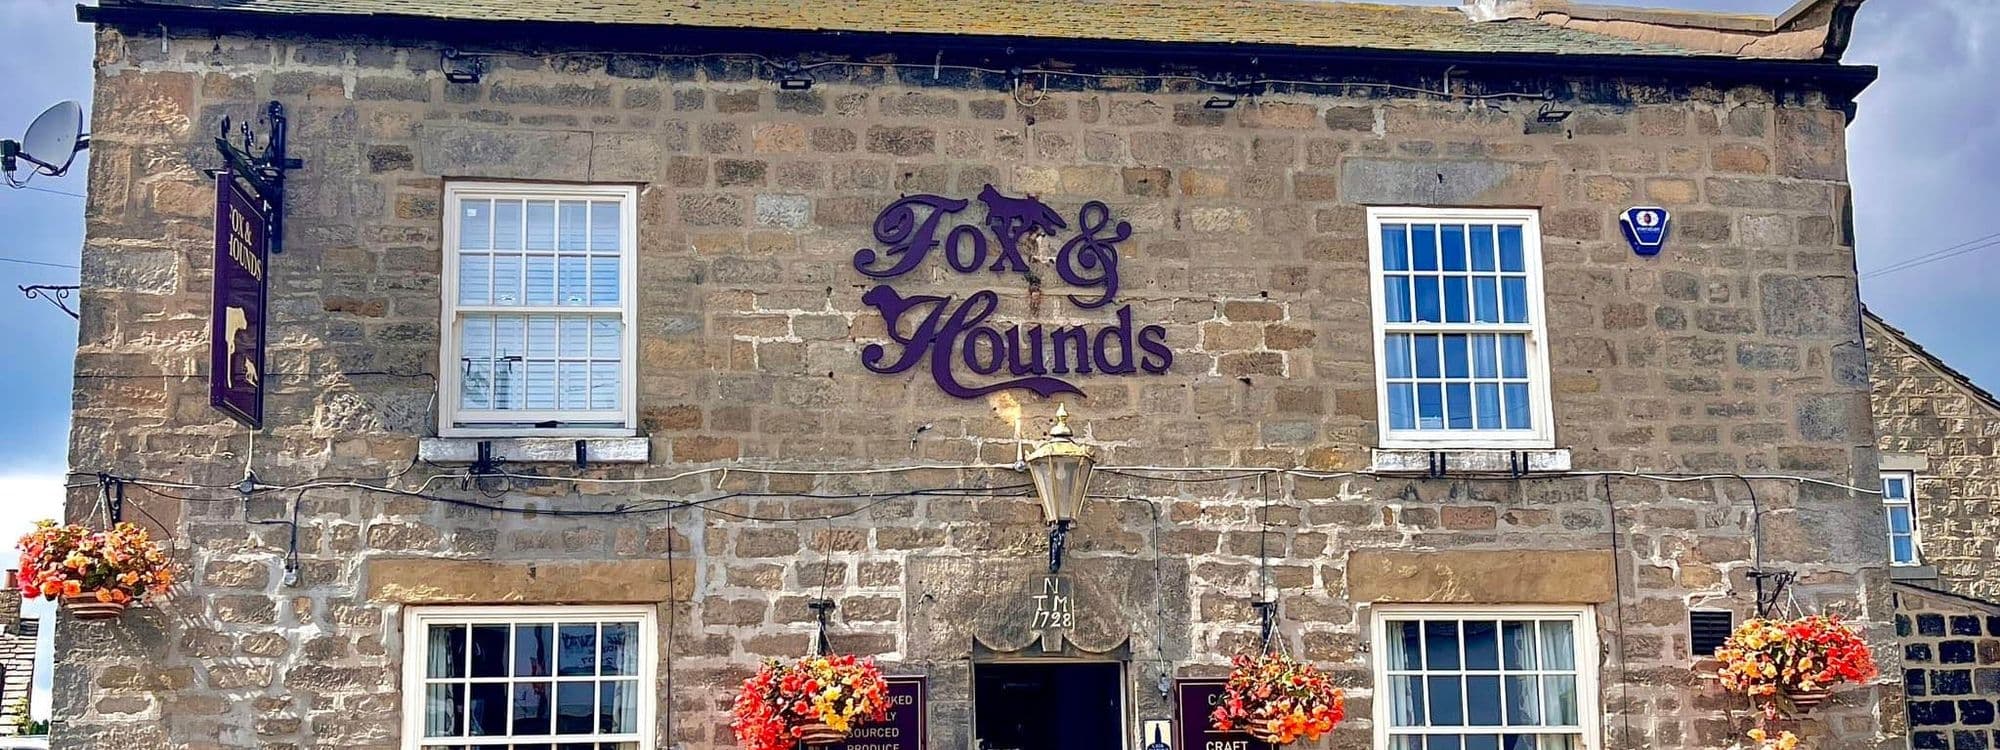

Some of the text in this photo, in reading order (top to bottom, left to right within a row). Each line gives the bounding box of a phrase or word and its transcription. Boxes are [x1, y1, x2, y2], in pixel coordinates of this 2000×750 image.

[229, 204, 252, 246] OX &
[854, 193, 1132, 309] Fox &
[862, 285, 1173, 399] Hounds
[1044, 577, 1059, 594] N
[1031, 610, 1072, 628] 1728
[848, 727, 900, 738] SOURCED
[1206, 741, 1248, 750] CRAFT
